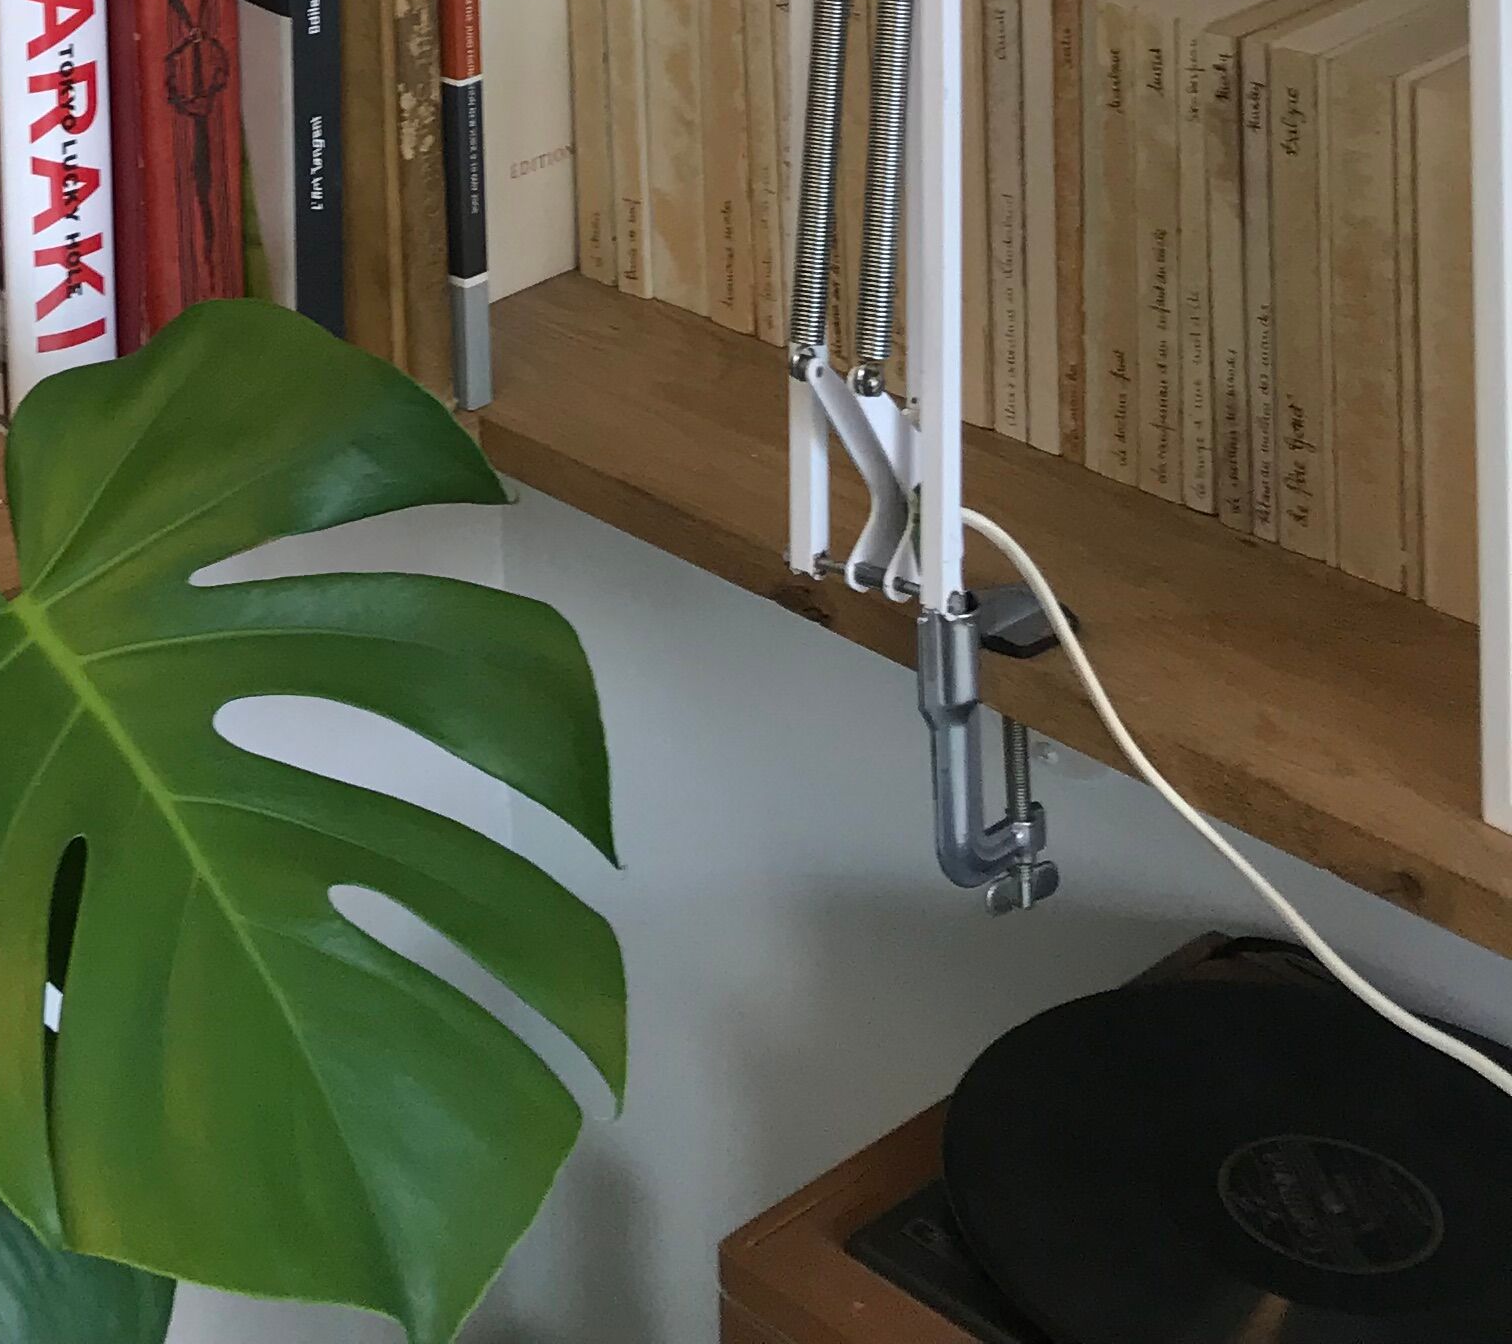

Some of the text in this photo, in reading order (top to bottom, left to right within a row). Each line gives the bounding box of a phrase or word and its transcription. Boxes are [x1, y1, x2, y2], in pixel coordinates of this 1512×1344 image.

[307, 0, 322, 34] Odile
[57, 43, 85, 301] TOKYO LUCKY HOLE
